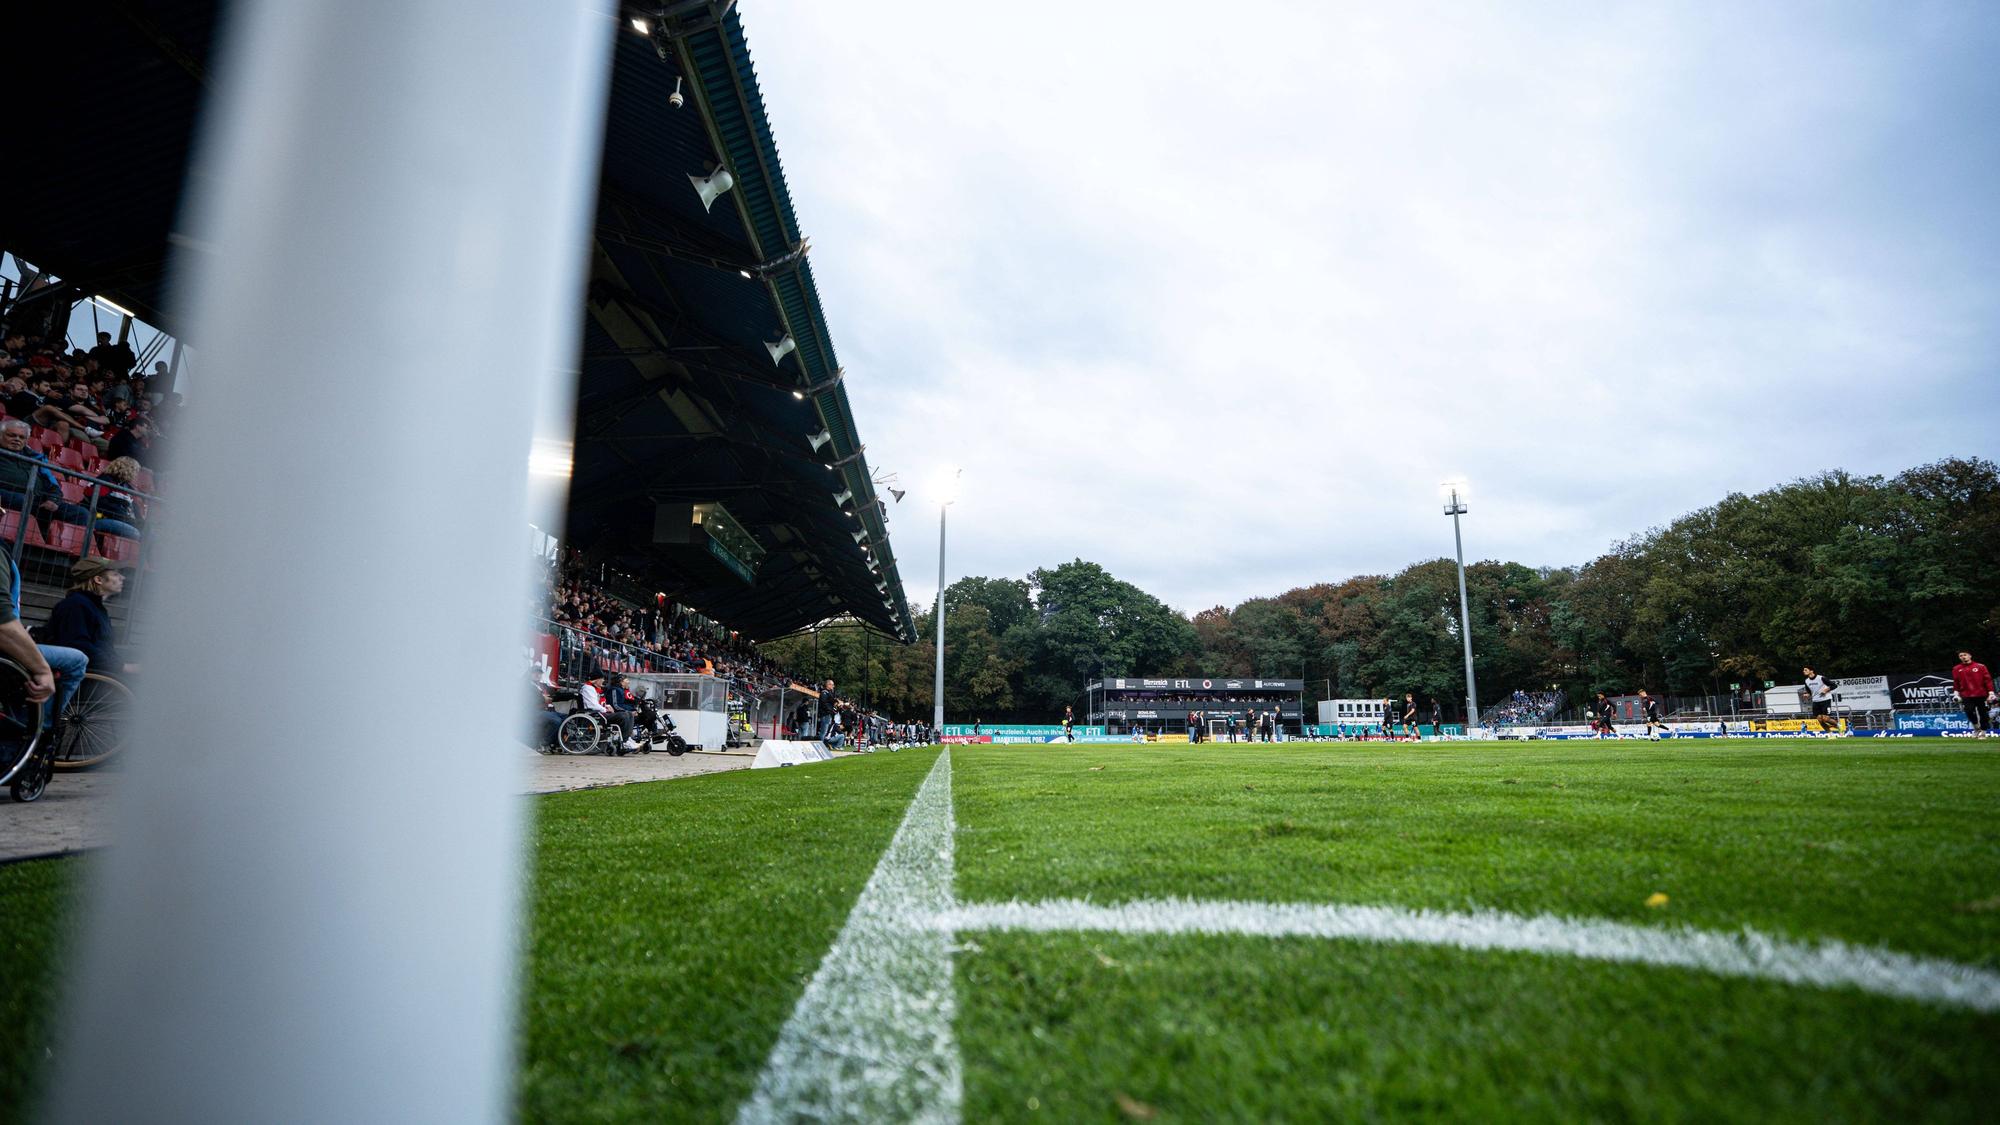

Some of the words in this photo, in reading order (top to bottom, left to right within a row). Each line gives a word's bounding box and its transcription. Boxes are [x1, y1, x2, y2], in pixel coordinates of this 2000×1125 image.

[1175, 680, 1191, 689] ETL
[1843, 677, 1882, 686] ROGGENDORF
[945, 726, 962, 736] ETL
